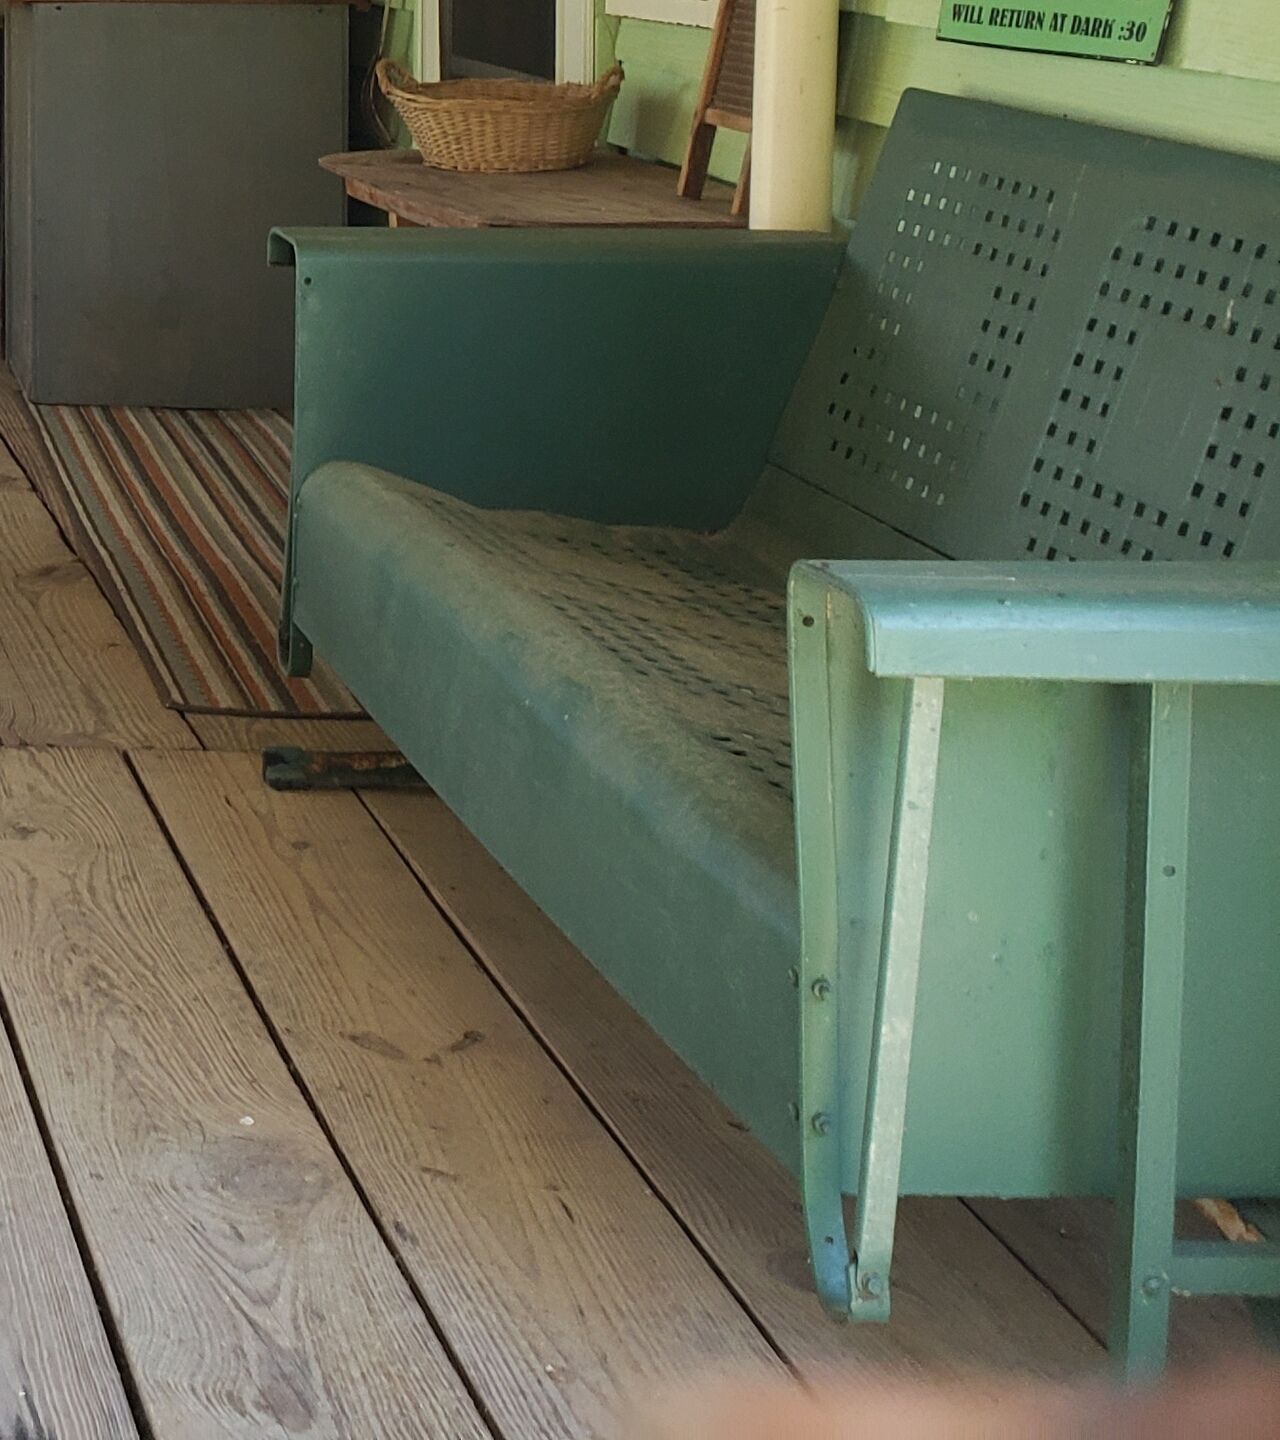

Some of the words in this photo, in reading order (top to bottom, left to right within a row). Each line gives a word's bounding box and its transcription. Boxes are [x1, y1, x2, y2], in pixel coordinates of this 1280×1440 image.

[951, 2, 984, 26] WILL
[988, 6, 1045, 32] RETURN
[1049, 11, 1069, 32] AT
[1069, 14, 1114, 39] DARK
